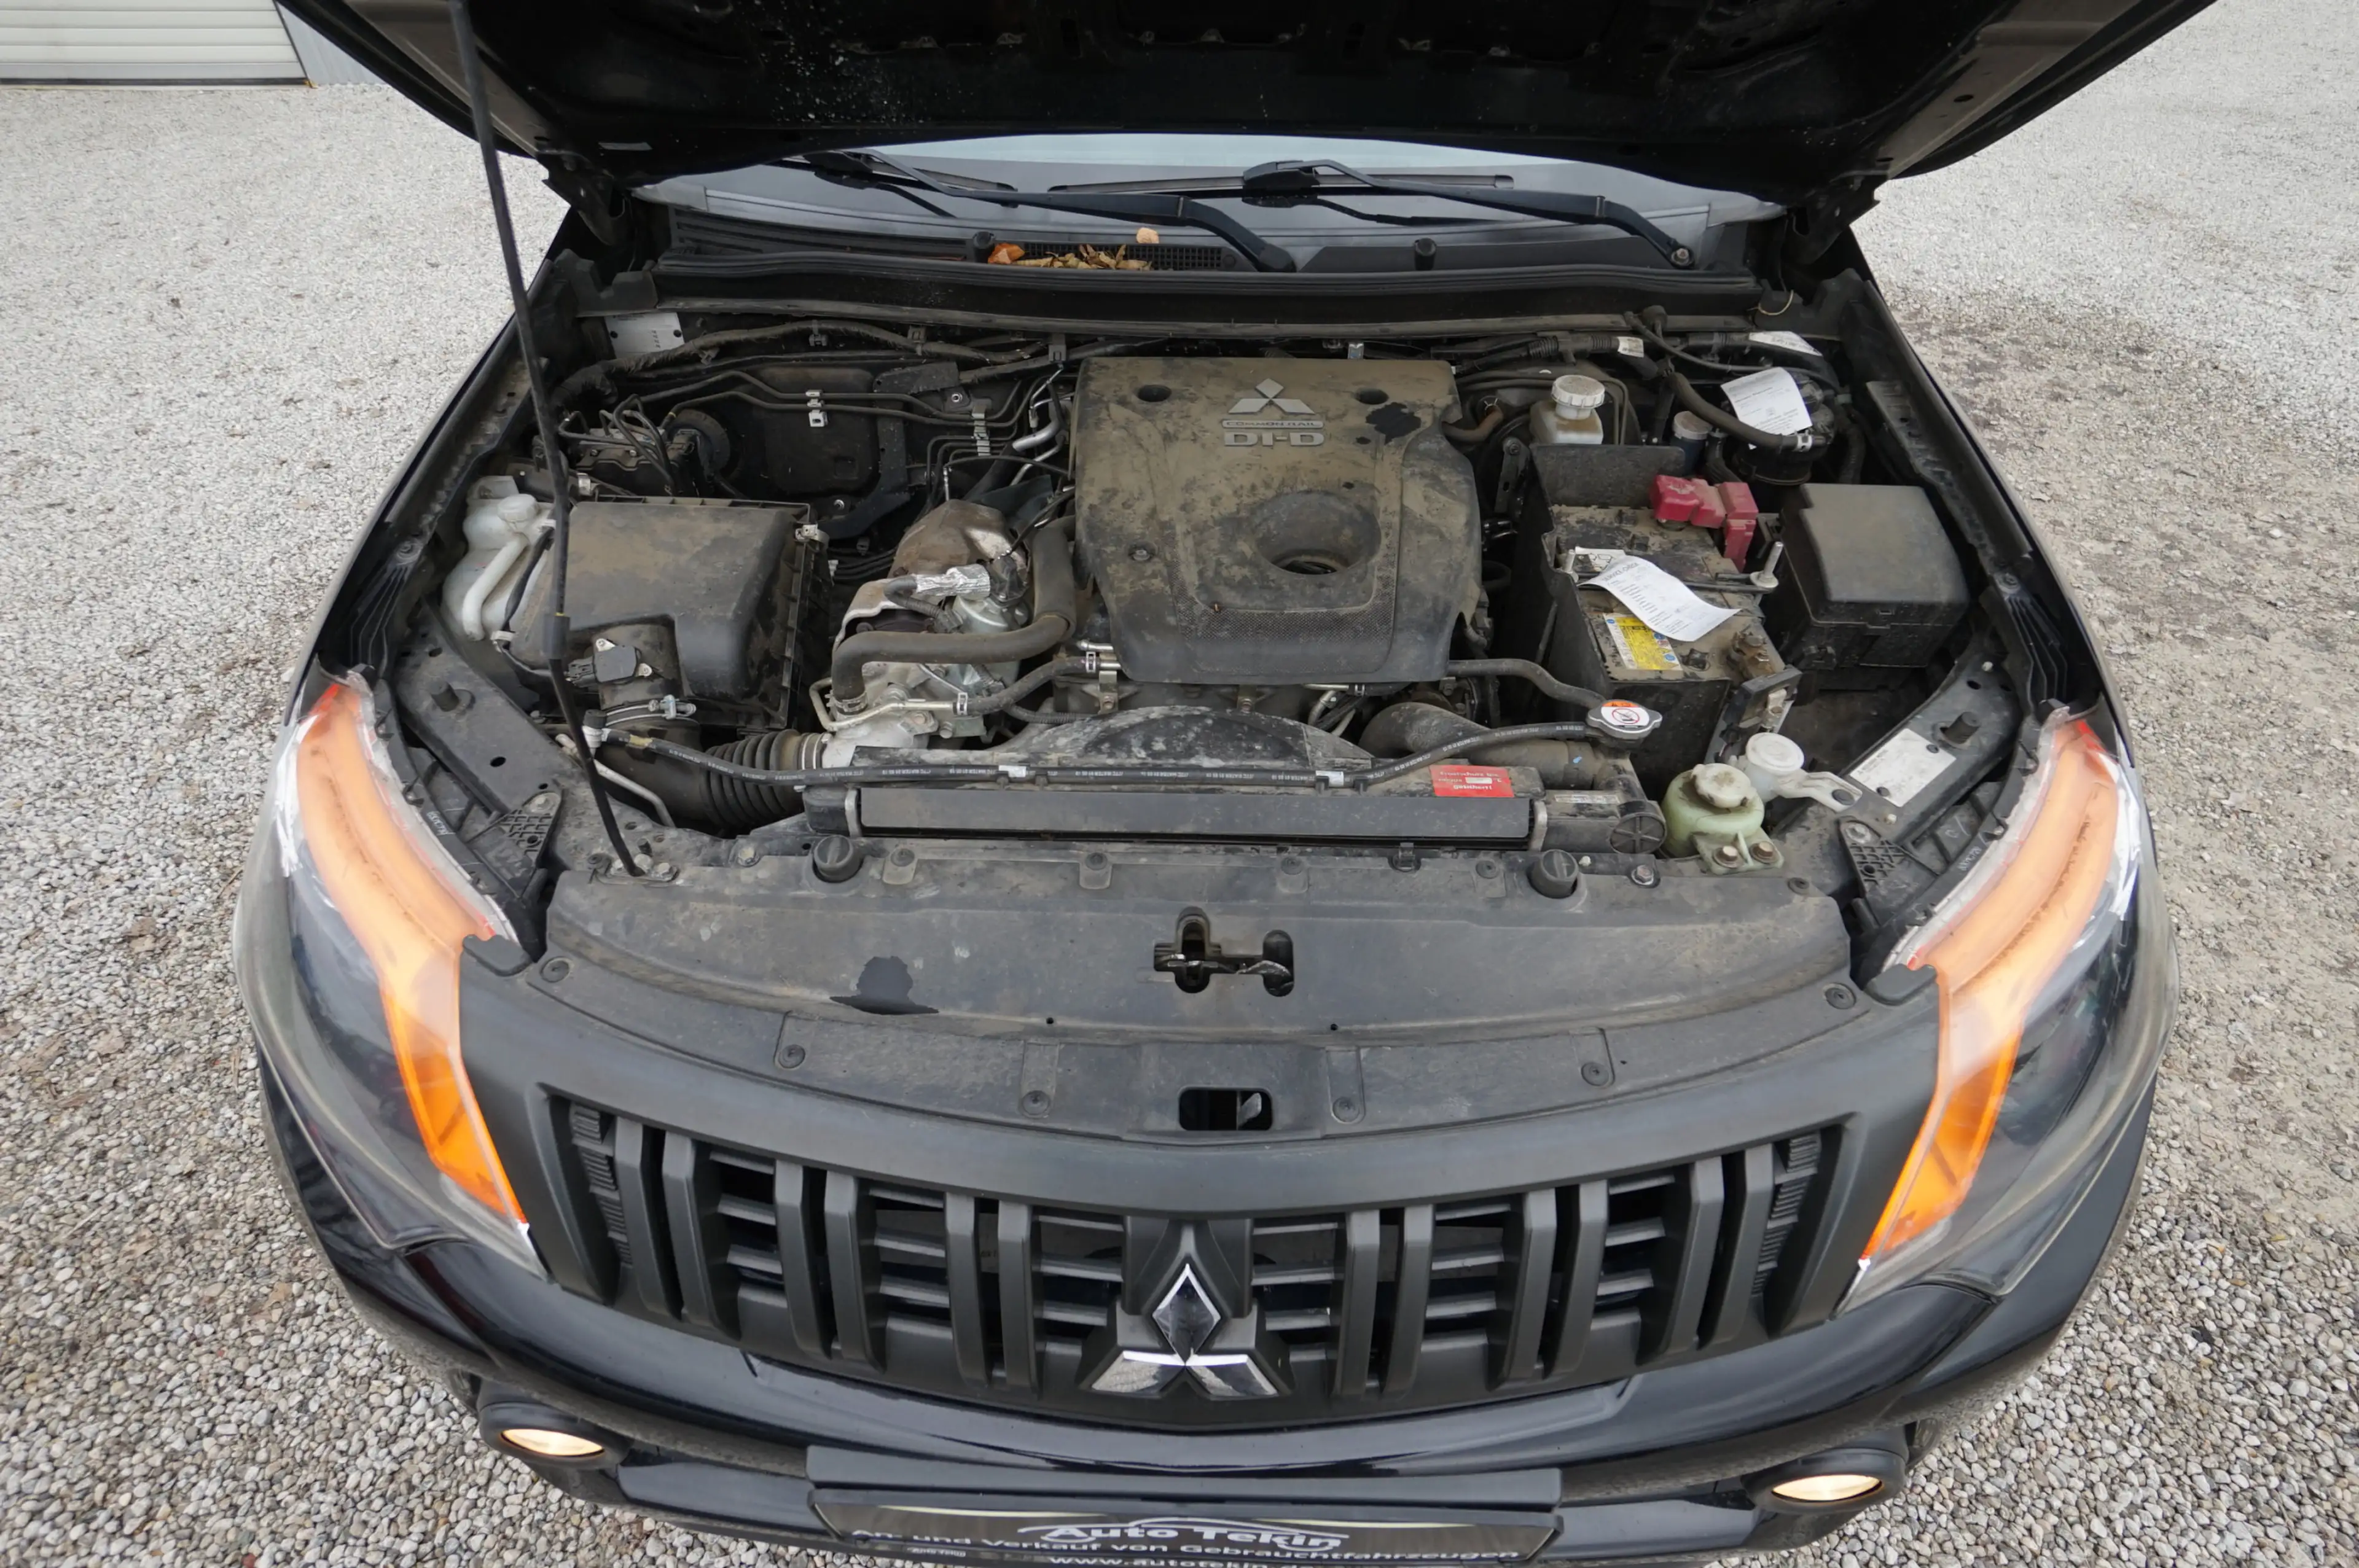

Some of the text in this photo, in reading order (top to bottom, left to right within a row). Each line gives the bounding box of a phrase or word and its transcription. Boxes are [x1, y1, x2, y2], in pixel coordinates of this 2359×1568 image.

[1224, 432, 1324, 447] DI-D
[913, 1535, 971, 1544] und
[982, 1539, 1101, 1550] Verkauf
[1042, 1526, 1342, 1547] Auto Tekin
